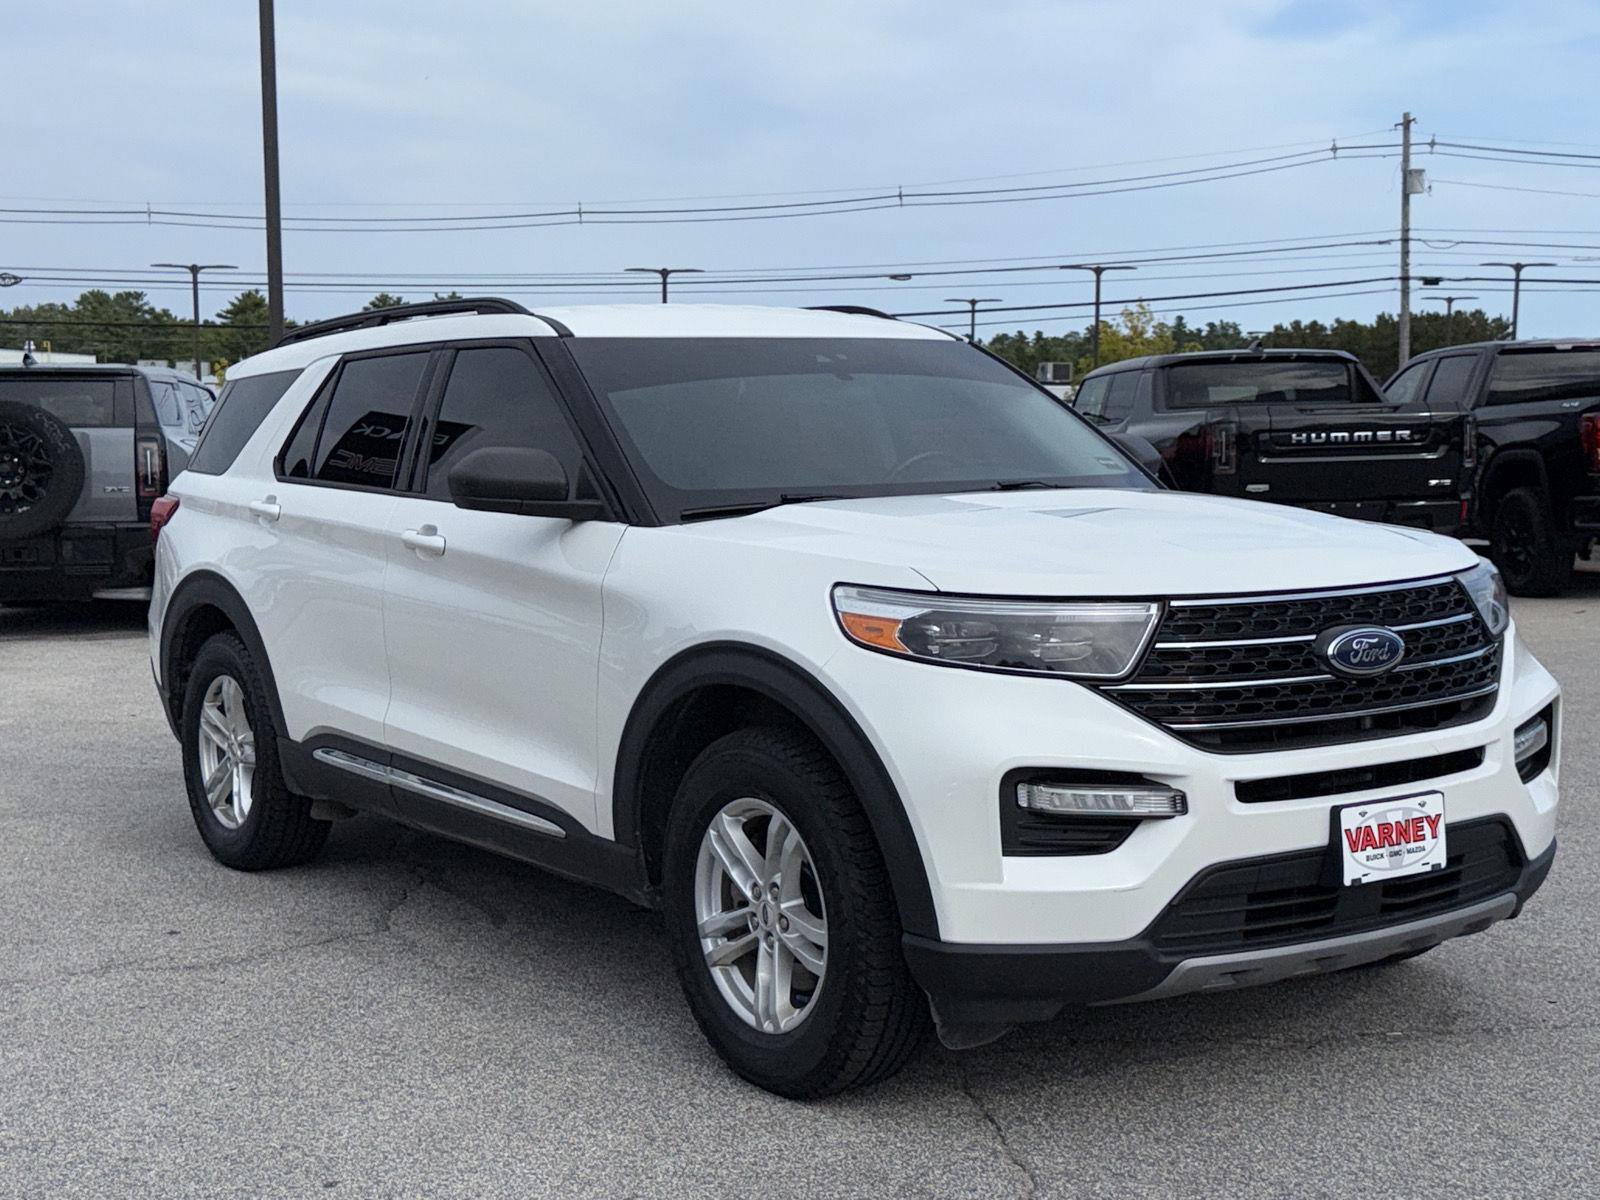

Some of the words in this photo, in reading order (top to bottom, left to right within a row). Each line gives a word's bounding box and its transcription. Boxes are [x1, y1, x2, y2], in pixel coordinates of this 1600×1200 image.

[1291, 430, 1411, 443] HUMMER
[1350, 637, 1390, 664] Ford
[1344, 813, 1442, 853] VARNEY
